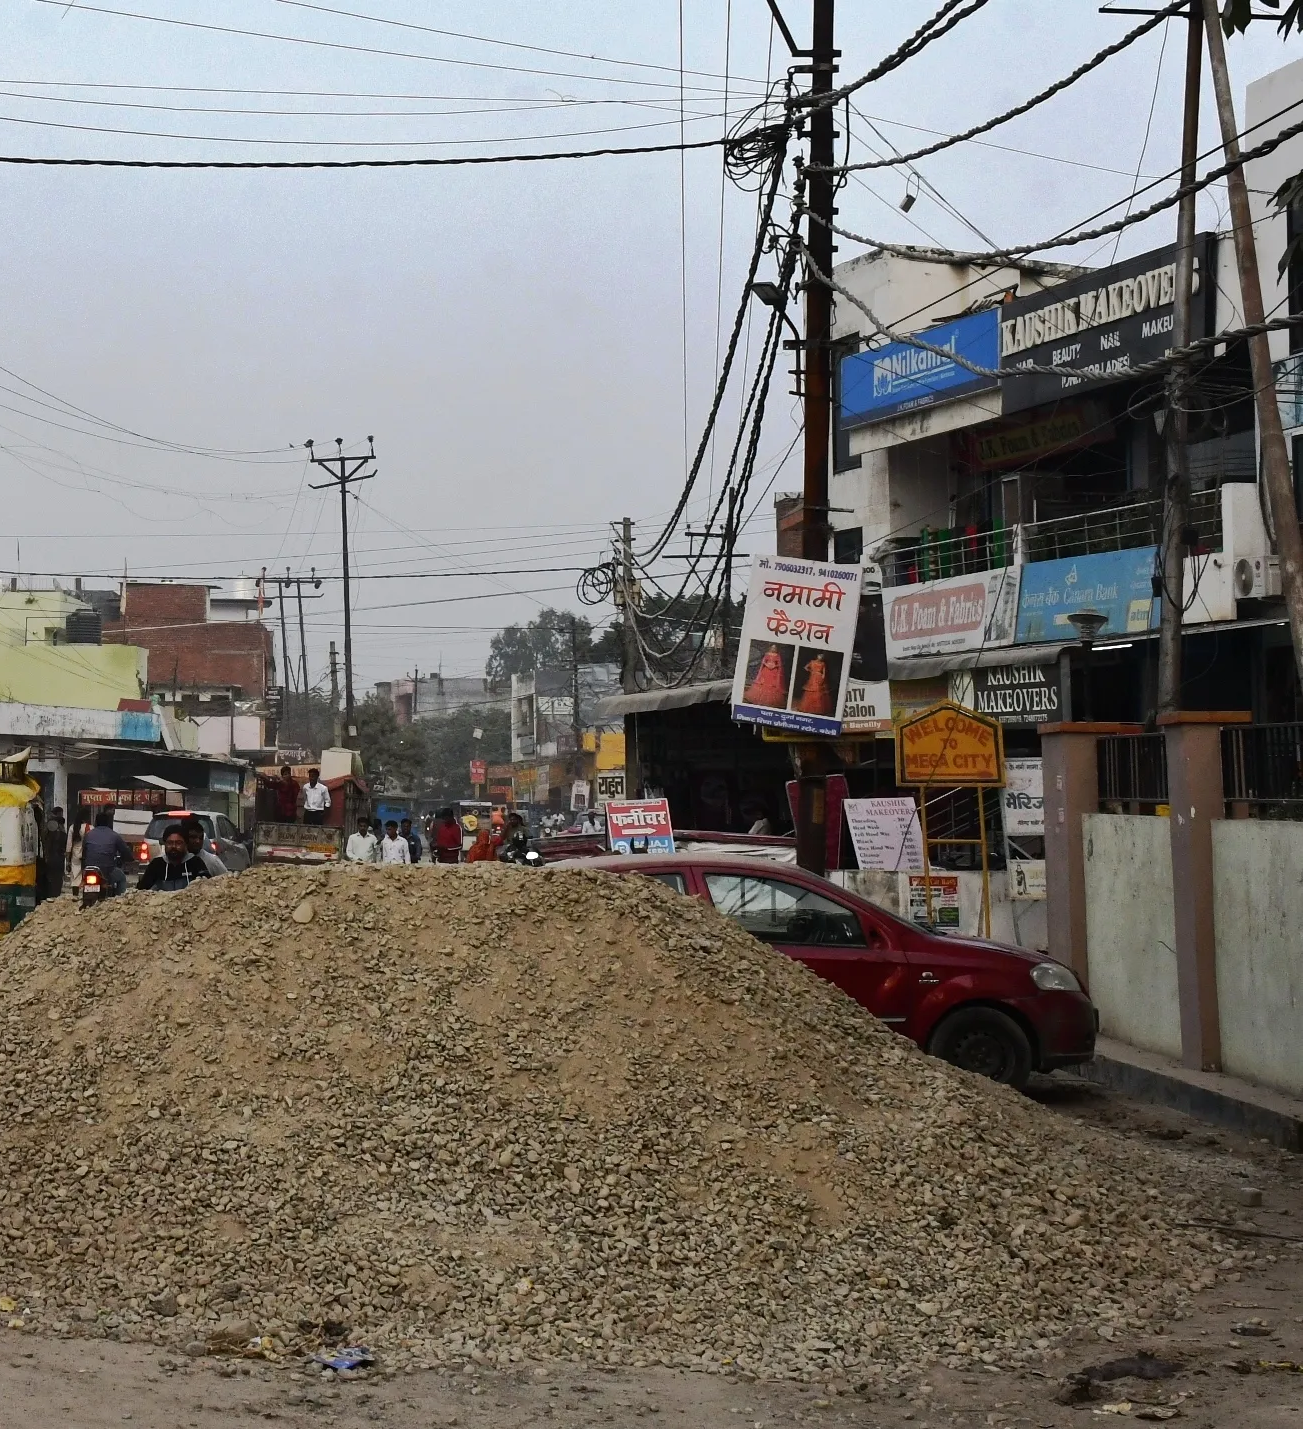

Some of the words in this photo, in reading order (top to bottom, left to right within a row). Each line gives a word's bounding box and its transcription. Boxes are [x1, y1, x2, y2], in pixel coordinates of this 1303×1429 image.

[1001, 297, 1079, 357] KAUSHIK
[1078, 257, 1200, 331] MAKEOVES
[1100, 331, 1121, 351] NAIL
[1141, 314, 1174, 338] MAKEU
[1052, 343, 1081, 366] BEAUTY
[818, 568, 858, 582] 9410260071
[763, 581, 847, 612] नमामी
[1064, 587, 1094, 604] Canara
[1096, 582, 1119, 601] Bank
[912, 602, 936, 631] Foam
[938, 598, 947, 627] &
[948, 592, 983, 626] Fabrics
[767, 608, 835, 645] फैशन
[987, 664, 1045, 686] KAUSHIK
[977, 686, 1058, 713] MAKEOVERS
[849, 721, 881, 729] Bareilly
[904, 717, 992, 747] WELCOME
[940, 738, 957, 750] TO
[905, 753, 949, 769] MEGA
[952, 753, 993, 769] CITY
[598, 775, 625, 799] राहुल
[866, 808, 915, 816] MAKEOVERS
[870, 800, 907, 808] KAUSHIK
[609, 807, 667, 827] फर्नीचर
